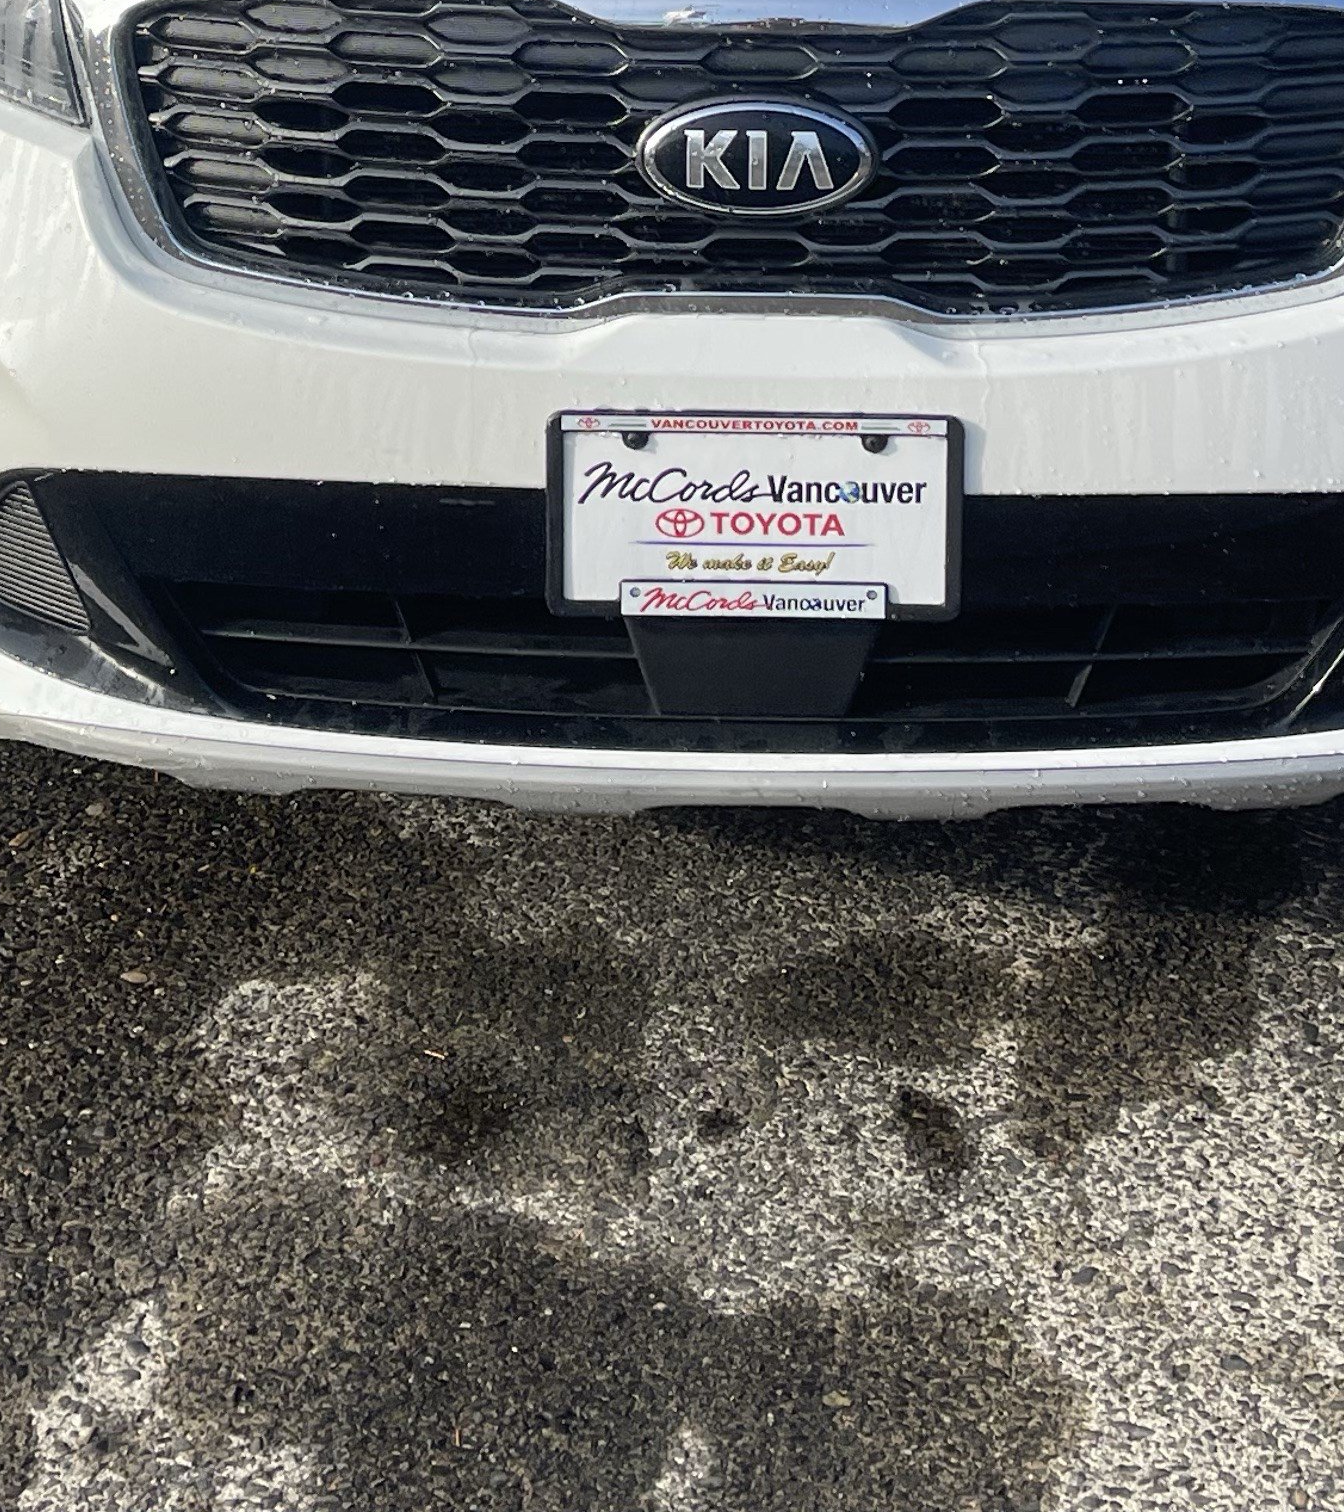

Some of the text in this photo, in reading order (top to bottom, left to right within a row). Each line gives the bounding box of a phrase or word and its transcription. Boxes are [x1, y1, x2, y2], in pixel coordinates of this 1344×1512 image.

[684, 129, 834, 190] KIA
[651, 419, 858, 430] VANCOUVERTOYOTA.COM
[578, 461, 927, 503] McCords Vancouver
[710, 512, 845, 536] TOYOTA
[666, 551, 836, 576] We make it Easy!
[640, 588, 759, 612] McCords
